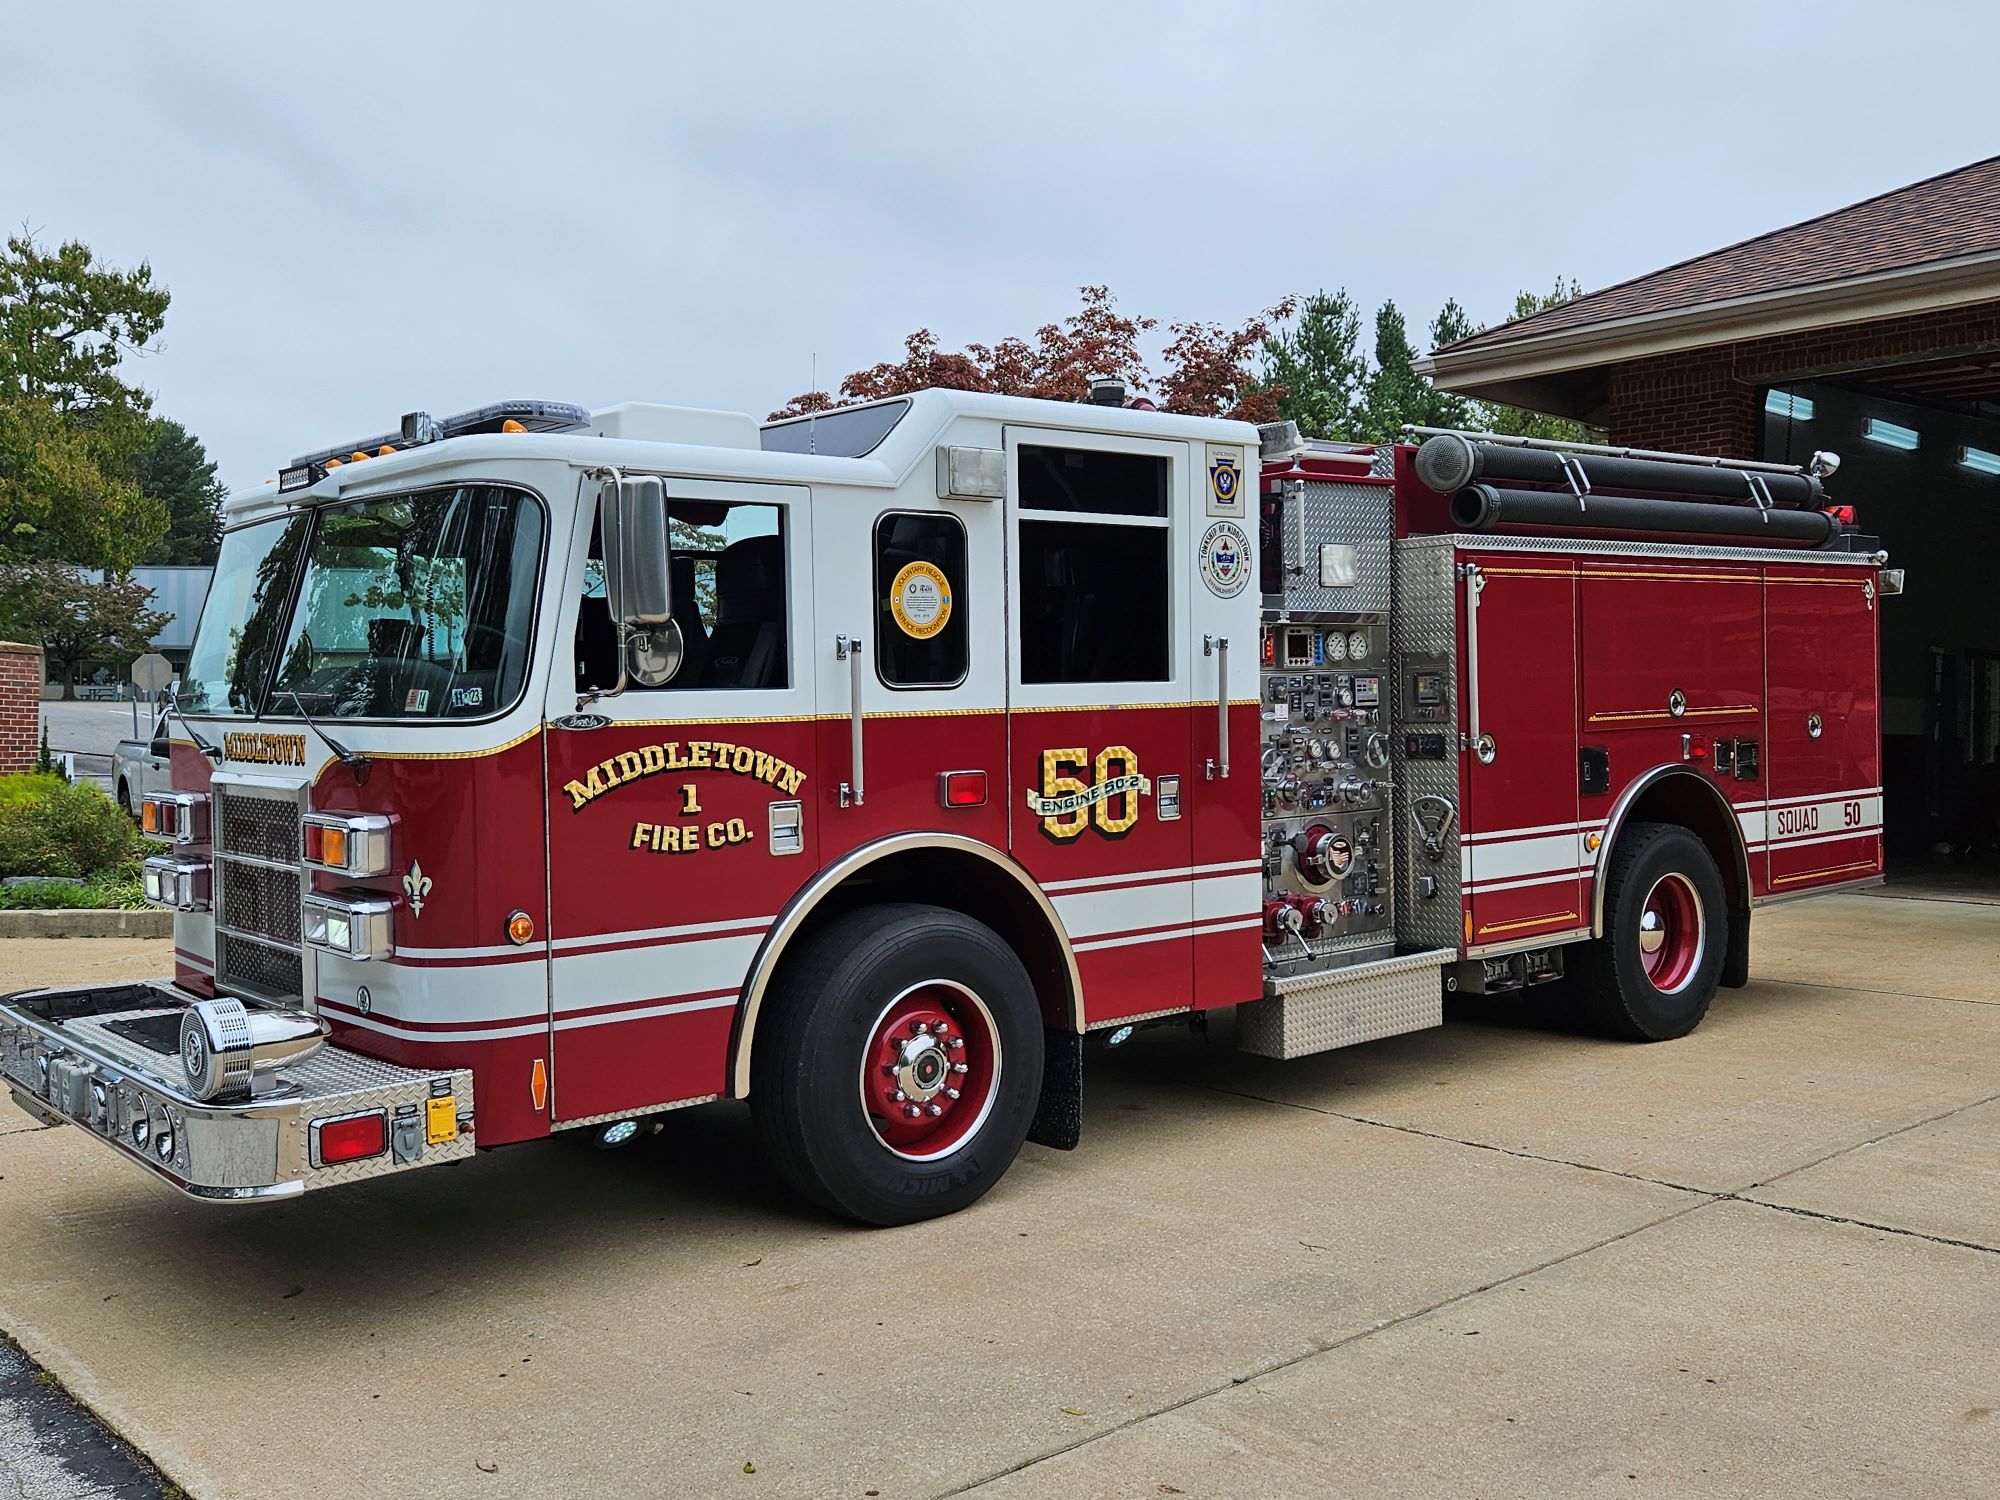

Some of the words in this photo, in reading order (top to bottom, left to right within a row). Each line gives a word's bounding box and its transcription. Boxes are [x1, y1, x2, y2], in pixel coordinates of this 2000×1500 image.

[1201, 527, 1217, 559] TOWNSHIP
[1218, 524, 1226, 534] OF
[1228, 525, 1249, 561] MIDDLETOWN
[897, 566, 925, 587] VOLUNTARY
[925, 567, 945, 588] RESCUE
[896, 609, 915, 632] SERVICE
[916, 609, 947, 634] RECOGNITION
[224, 732, 305, 765] MIDDLETOWN
[562, 740, 808, 812] MIDDLETOWN
[1040, 745, 1139, 841] 50
[680, 783, 703, 815] 1
[1041, 787, 1100, 812] ENGINE
[1104, 775, 1140, 795] 50-2
[631, 821, 701, 853] FIRE
[706, 817, 755, 848] CO.
[1778, 807, 1818, 834] SQUAD
[1844, 802, 1860, 826] 50
